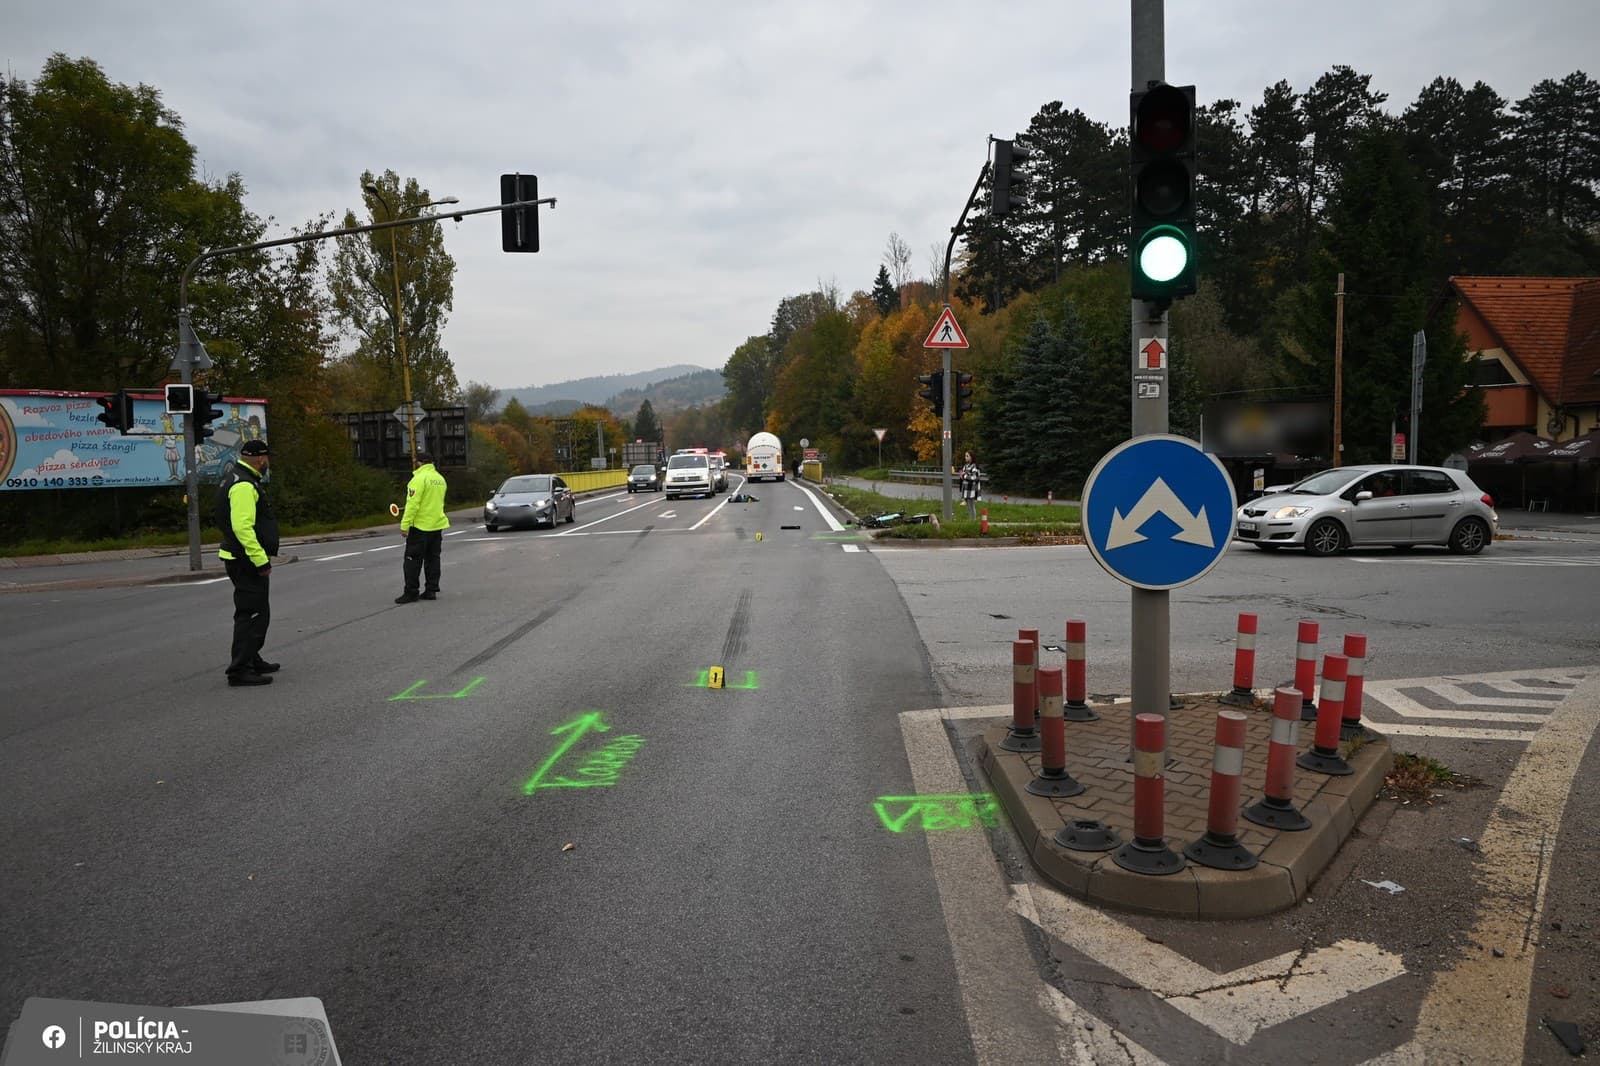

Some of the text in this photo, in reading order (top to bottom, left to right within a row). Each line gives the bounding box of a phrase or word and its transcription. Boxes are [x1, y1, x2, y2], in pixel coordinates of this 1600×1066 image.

[23, 401, 92, 415] Rozvoz pizze
[69, 412, 100, 426] bezlep
[24, 428, 116, 443] obedového menu
[71, 441, 99, 452] pizza
[36, 457, 121, 475] pizza sendvičov
[6, 478, 38, 488] 0910
[43, 477, 64, 487] 140
[68, 476, 88, 486] 333
